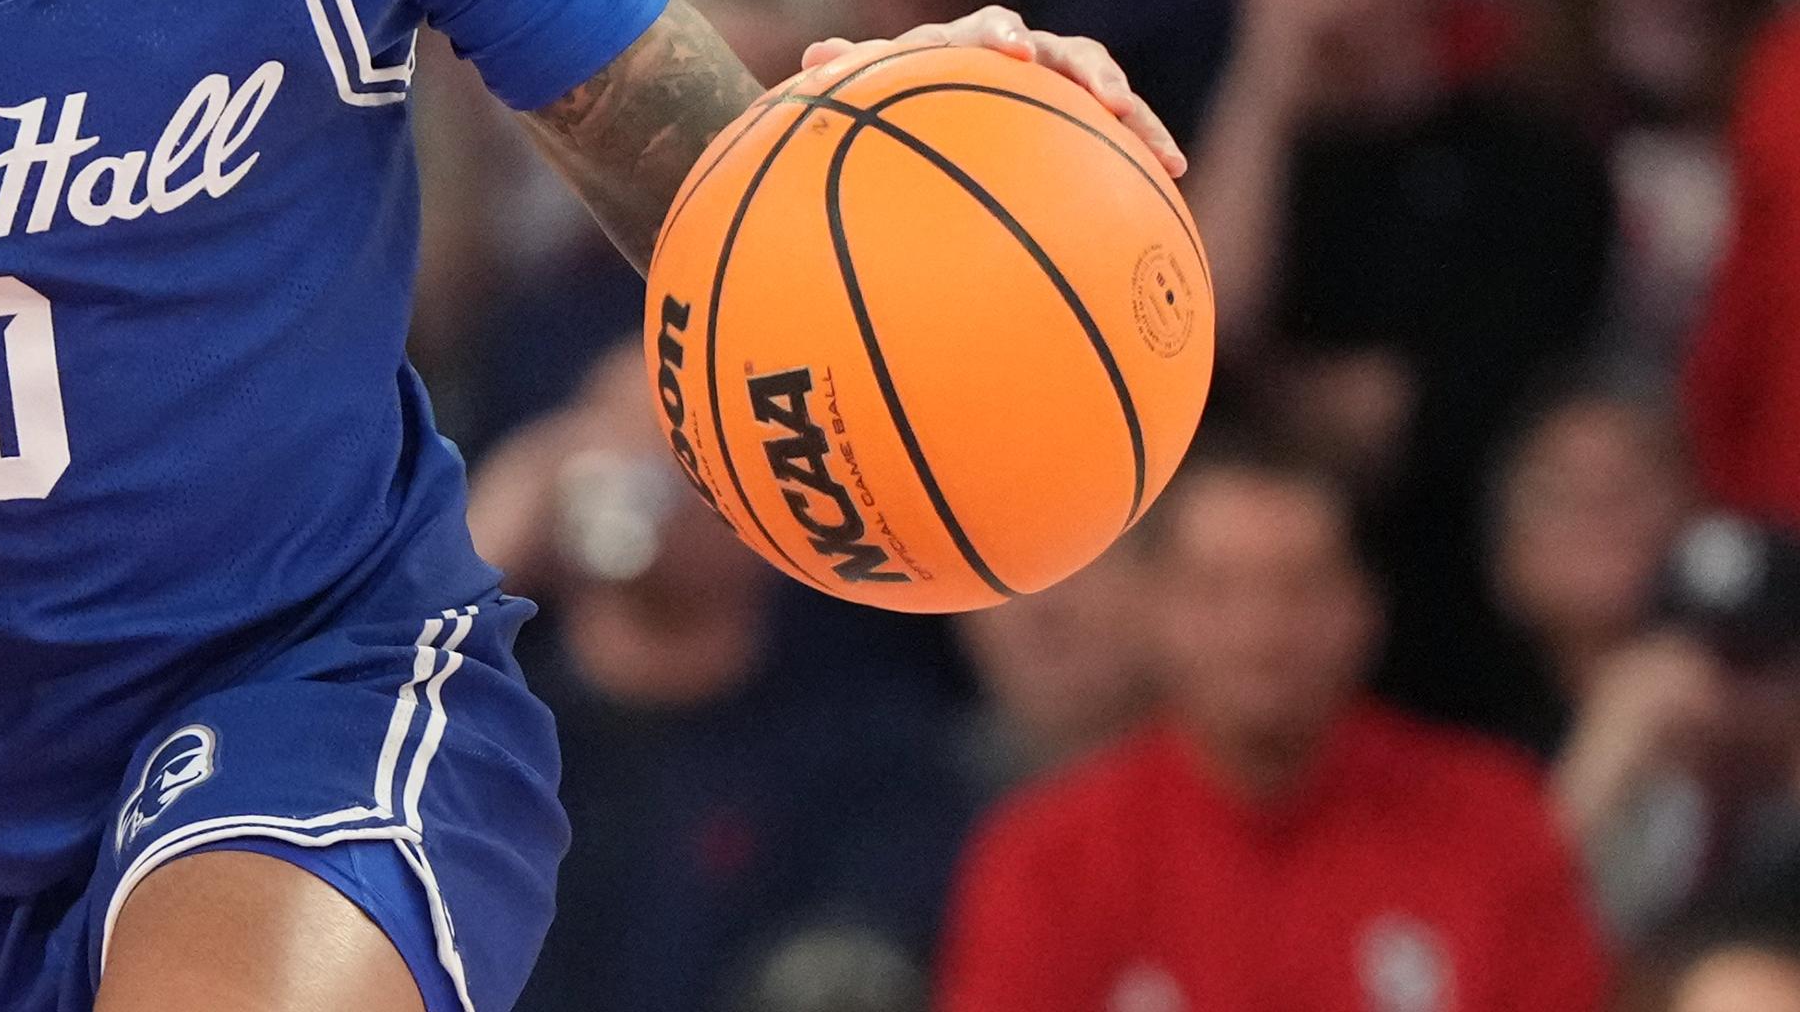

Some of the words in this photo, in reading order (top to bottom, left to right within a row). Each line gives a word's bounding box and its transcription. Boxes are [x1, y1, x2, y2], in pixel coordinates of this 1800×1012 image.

[822, 366, 846, 436] BALL
[747, 367, 912, 583] NCAA
[840, 441, 876, 508] GAME
